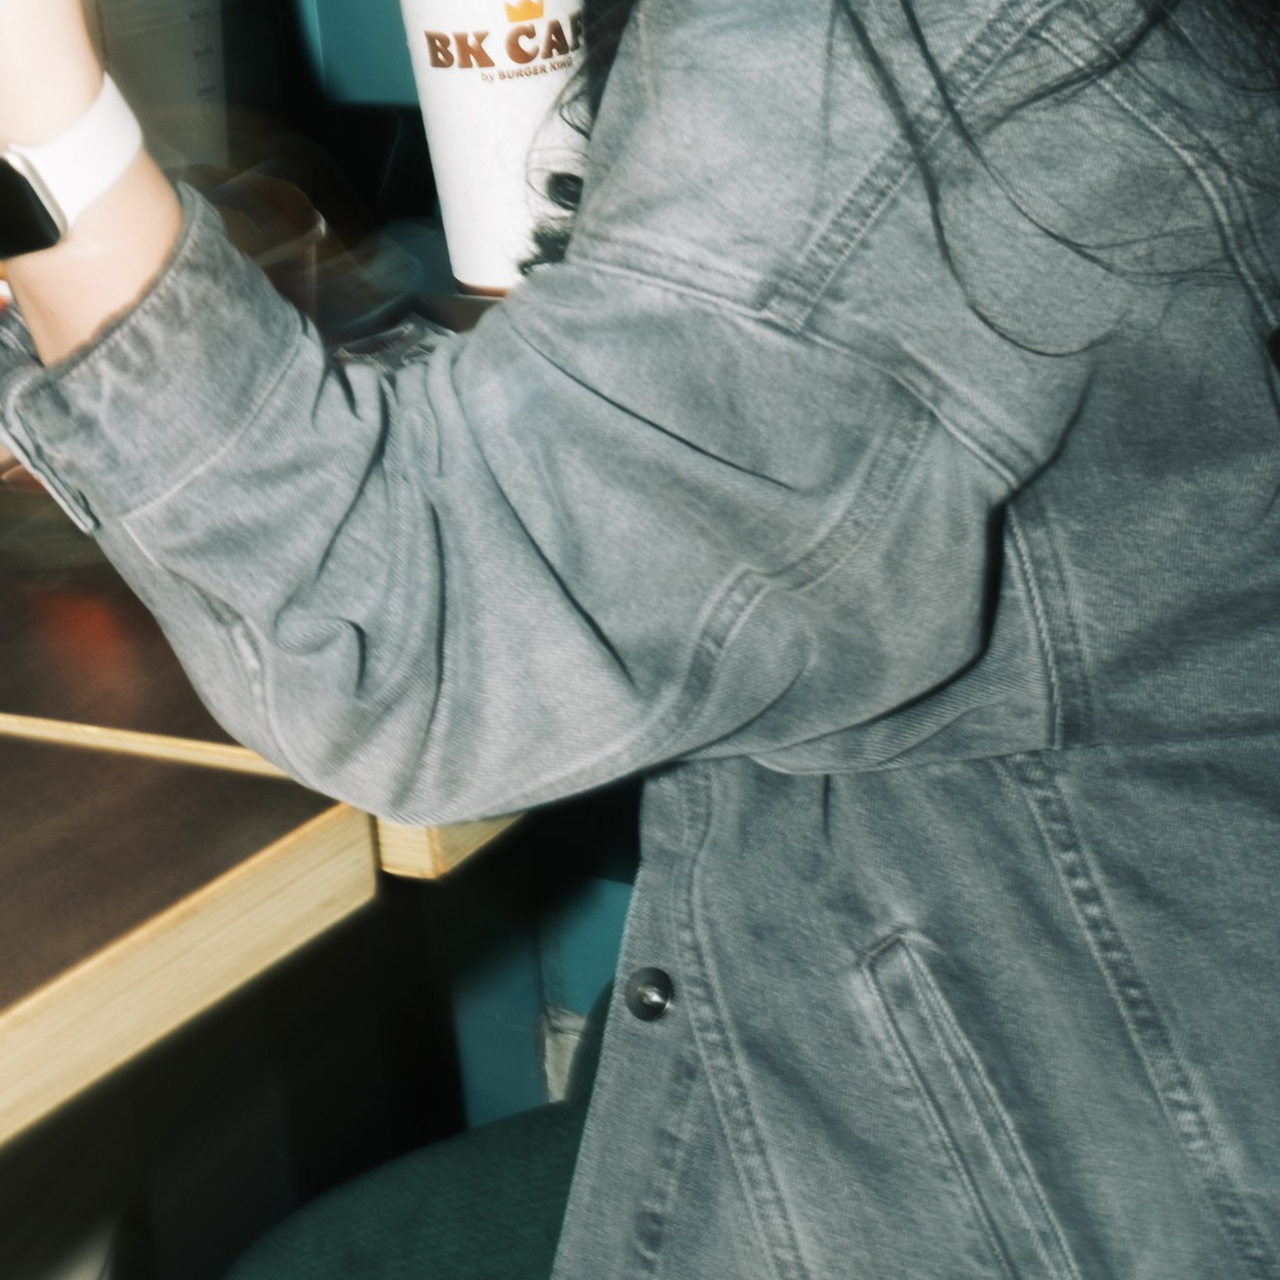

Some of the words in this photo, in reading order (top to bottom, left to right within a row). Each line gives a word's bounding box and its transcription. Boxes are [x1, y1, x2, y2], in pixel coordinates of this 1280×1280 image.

[424, 29, 495, 69] BK
[481, 71, 495, 83] by
[498, 66, 547, 81] BURGER
[550, 56, 573, 72] KING
